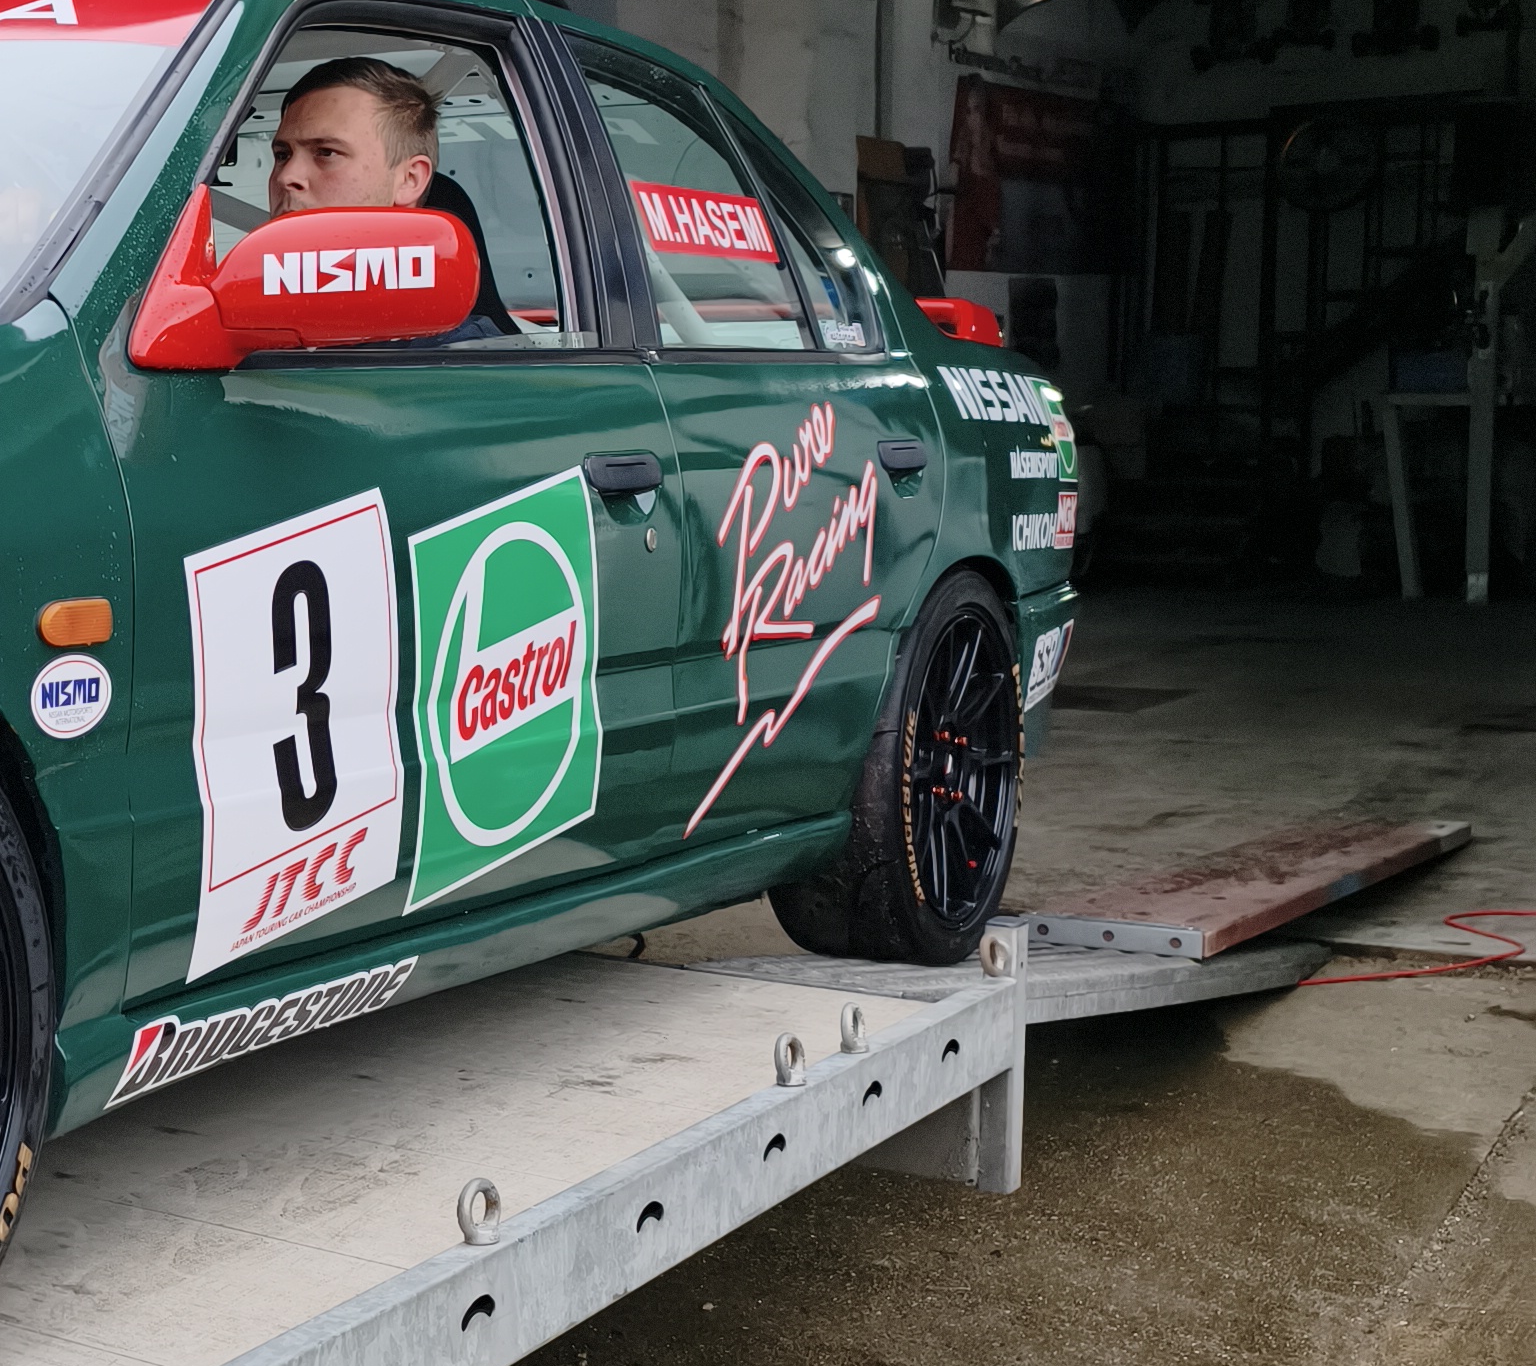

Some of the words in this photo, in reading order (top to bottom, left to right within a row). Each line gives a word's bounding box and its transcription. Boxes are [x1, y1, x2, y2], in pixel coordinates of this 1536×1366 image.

[638, 191, 773, 254] M.HASEMI
[263, 245, 435, 296] NISMO
[937, 364, 1050, 426] NISSAN
[718, 401, 835, 661] Pure
[1056, 495, 1078, 533] NGK
[736, 460, 877, 726] Racing
[41, 676, 101, 710] NISMO
[272, 559, 337, 832] 3
[458, 620, 577, 742] Castrol
[230, 931, 255, 953] JAPAN
[255, 916, 289, 940] TOURING
[288, 908, 303, 924] CAR
[303, 882, 357, 916] CHAMPIONSHIP
[242, 827, 369, 934] JTCC
[112, 962, 412, 1099] BRIDGESTONE
